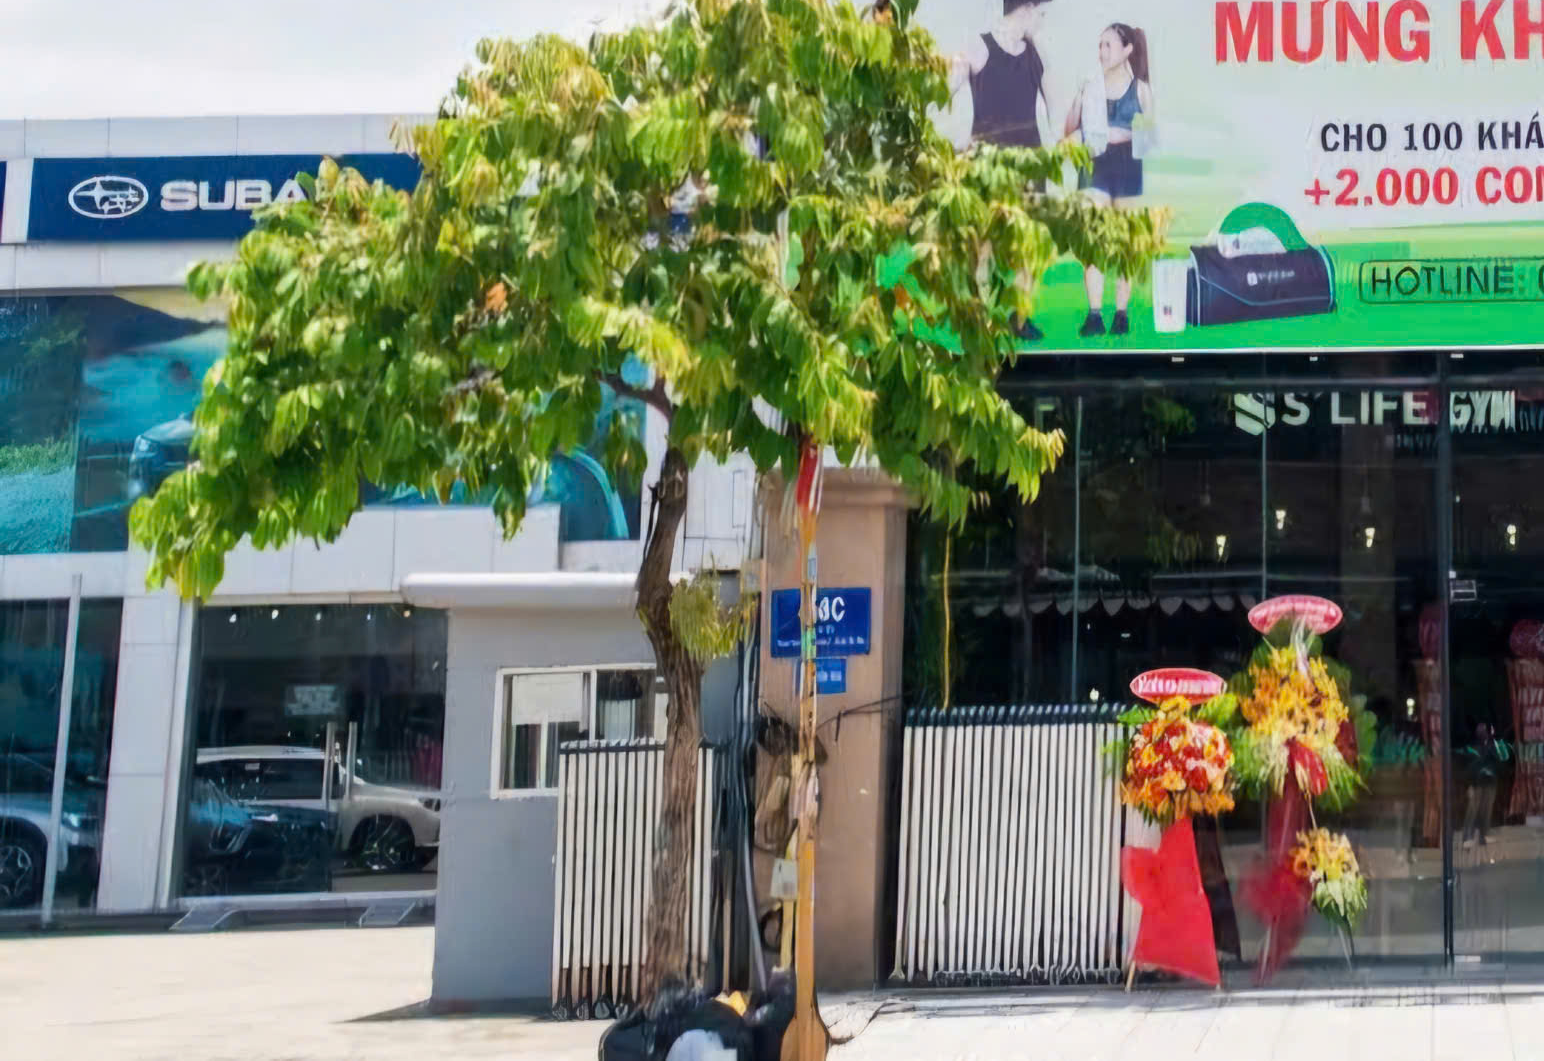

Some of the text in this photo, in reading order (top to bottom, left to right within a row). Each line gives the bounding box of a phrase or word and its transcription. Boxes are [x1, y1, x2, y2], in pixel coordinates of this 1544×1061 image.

[1320, 121, 1387, 152] CHO
[1403, 119, 1463, 151] 100
[160, 178, 316, 213] SUBA
[1303, 165, 1459, 207] +2.000
[1370, 261, 1526, 297] HOTLINE:
[1449, 390, 1517, 434] GYM
